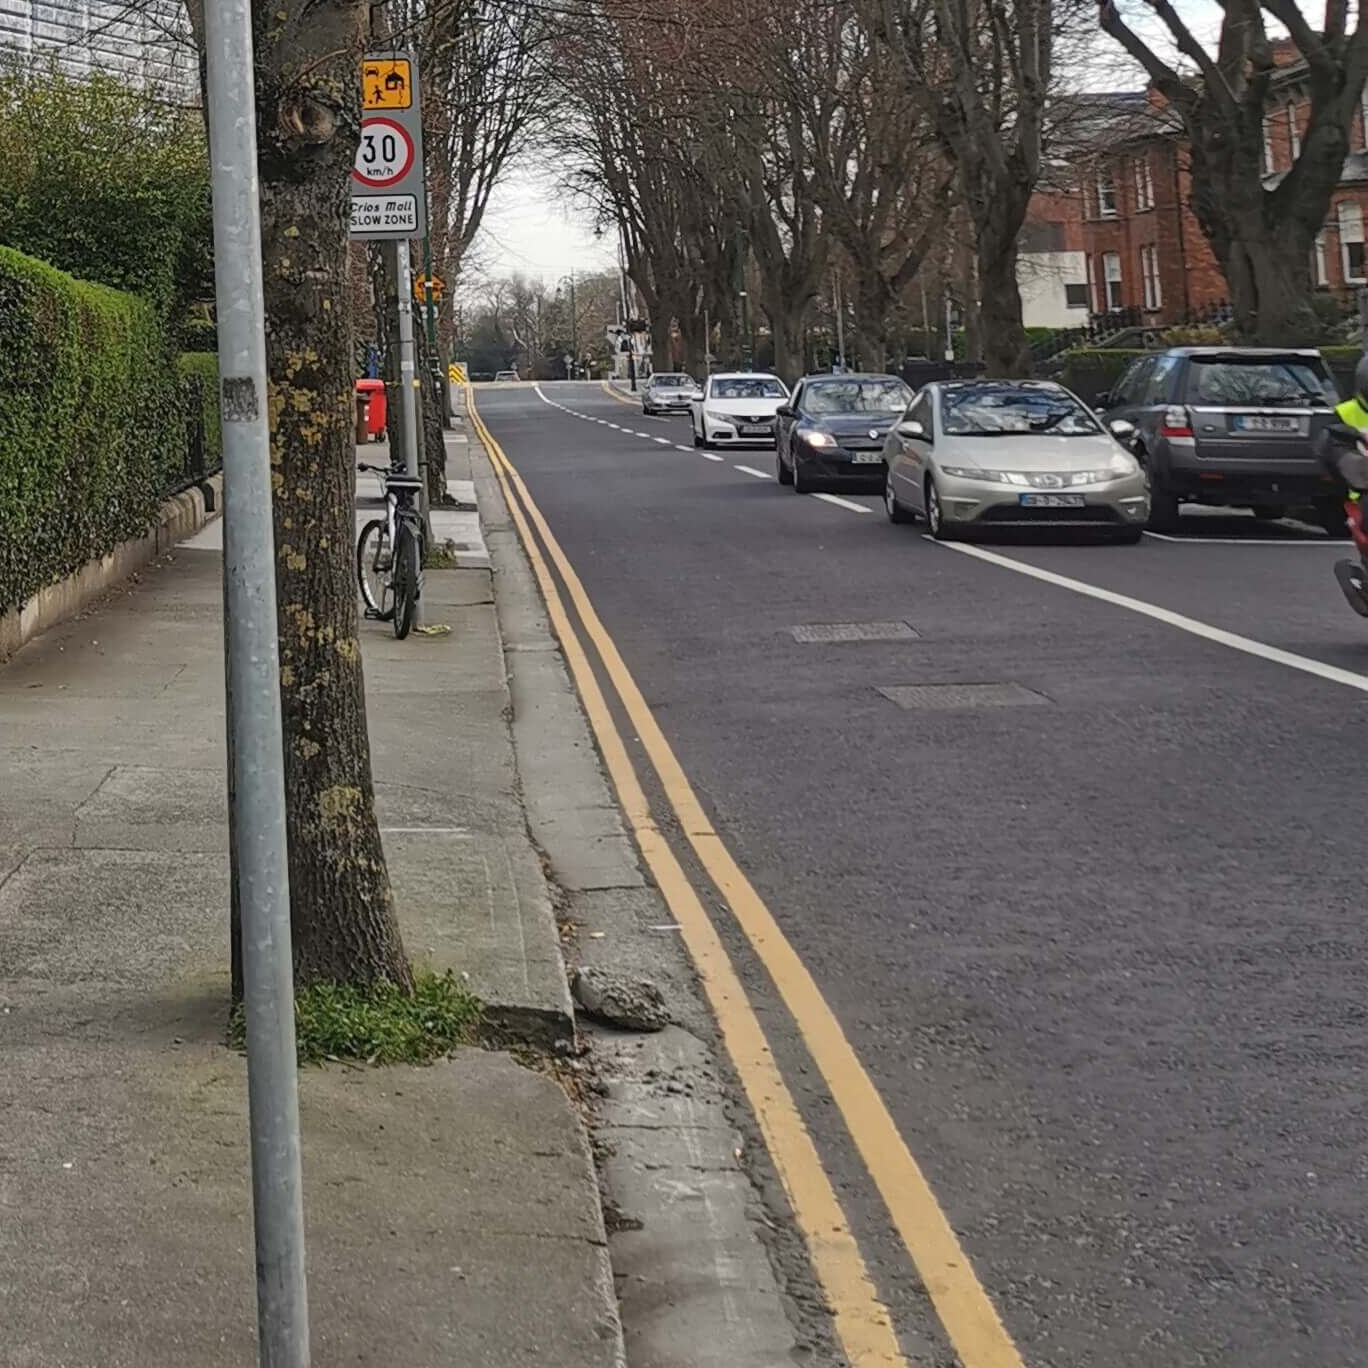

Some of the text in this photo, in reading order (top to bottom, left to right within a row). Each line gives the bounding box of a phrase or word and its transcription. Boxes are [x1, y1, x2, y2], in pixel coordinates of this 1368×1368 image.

[362, 134, 396, 163] 30
[367, 167, 394, 176] km/h
[351, 214, 413, 225] SLOW ZONE
